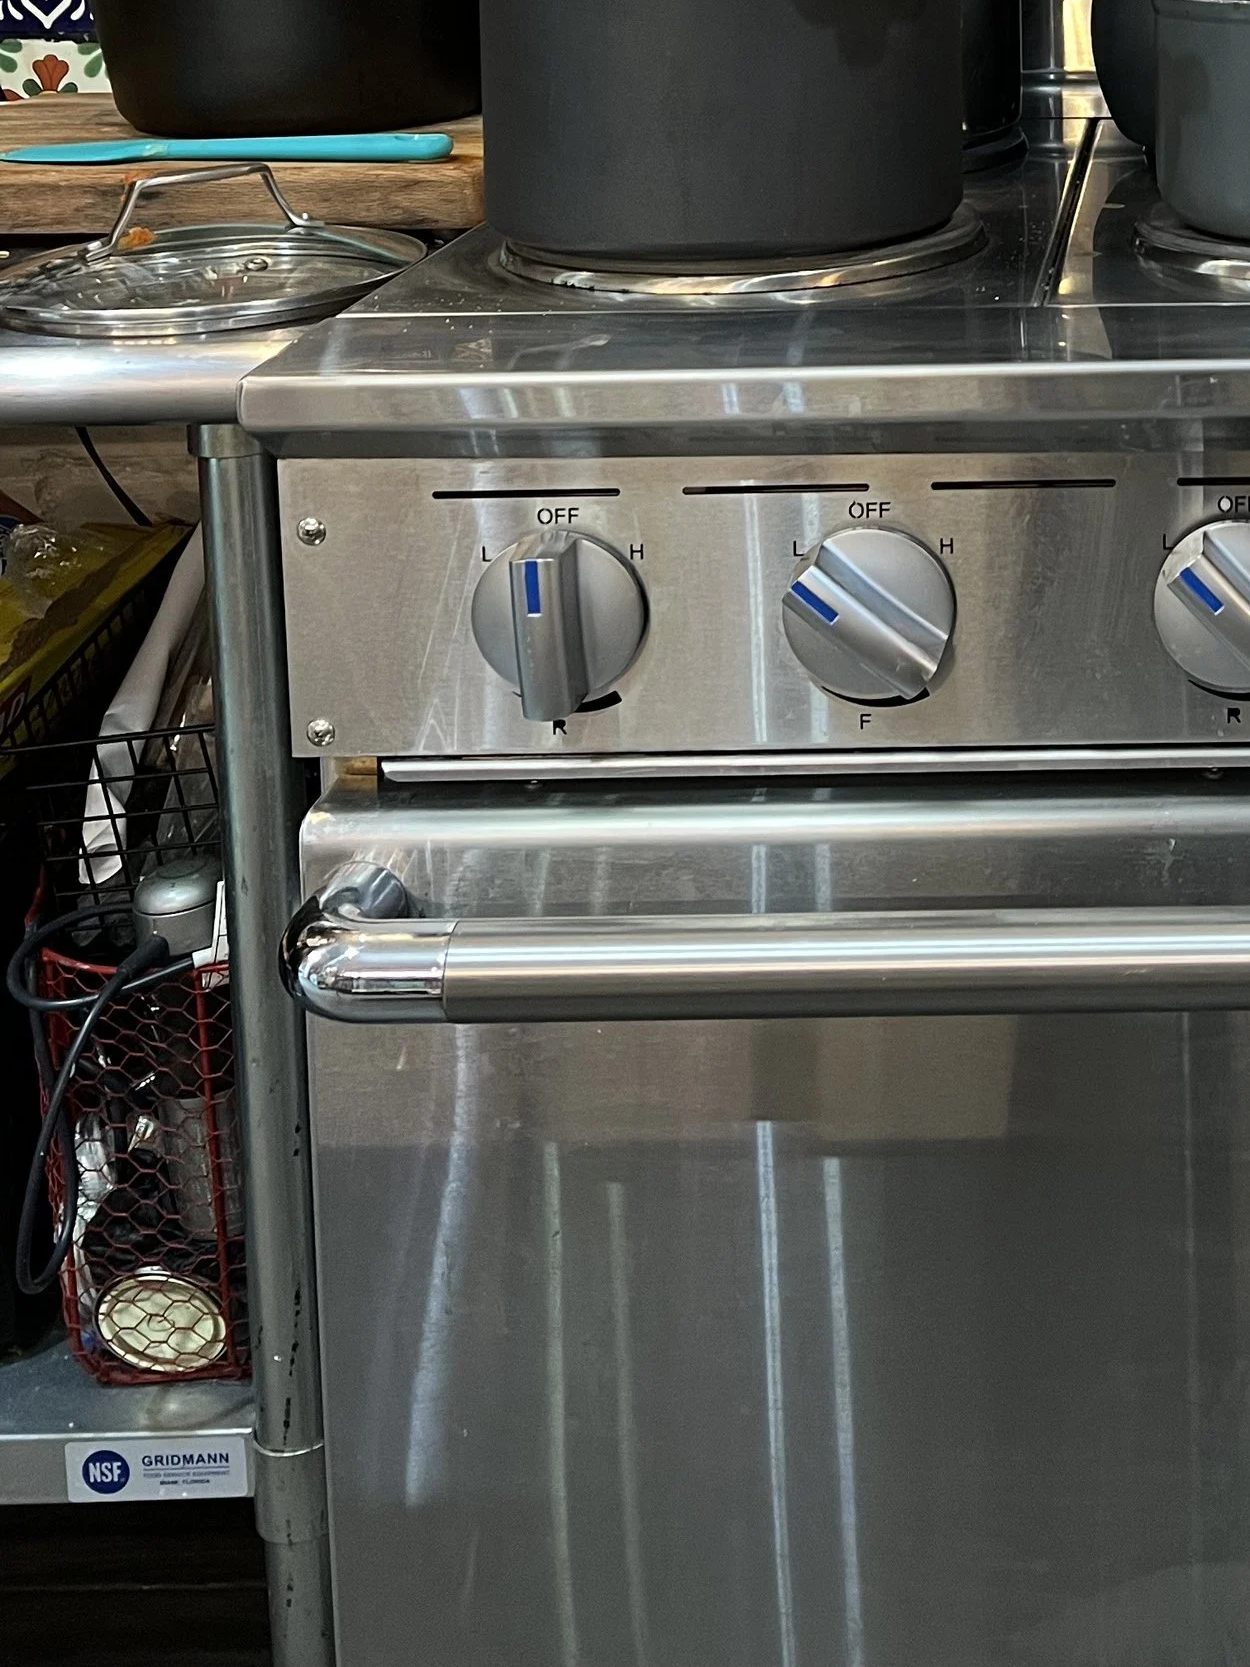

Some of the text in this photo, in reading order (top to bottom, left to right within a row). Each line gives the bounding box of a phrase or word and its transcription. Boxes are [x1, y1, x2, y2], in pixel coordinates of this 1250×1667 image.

[537, 508, 579, 525] OFF
[848, 500, 891, 519] OFF
[793, 539, 803, 557] L
[940, 538, 954, 555] H
[1163, 533, 1173, 550] L
[482, 546, 492, 563] L
[631, 544, 644, 561] H
[860, 714, 871, 731] F
[1227, 708, 1241, 724] R
[88, 1453, 230, 1483] NSF GRIDMANN
